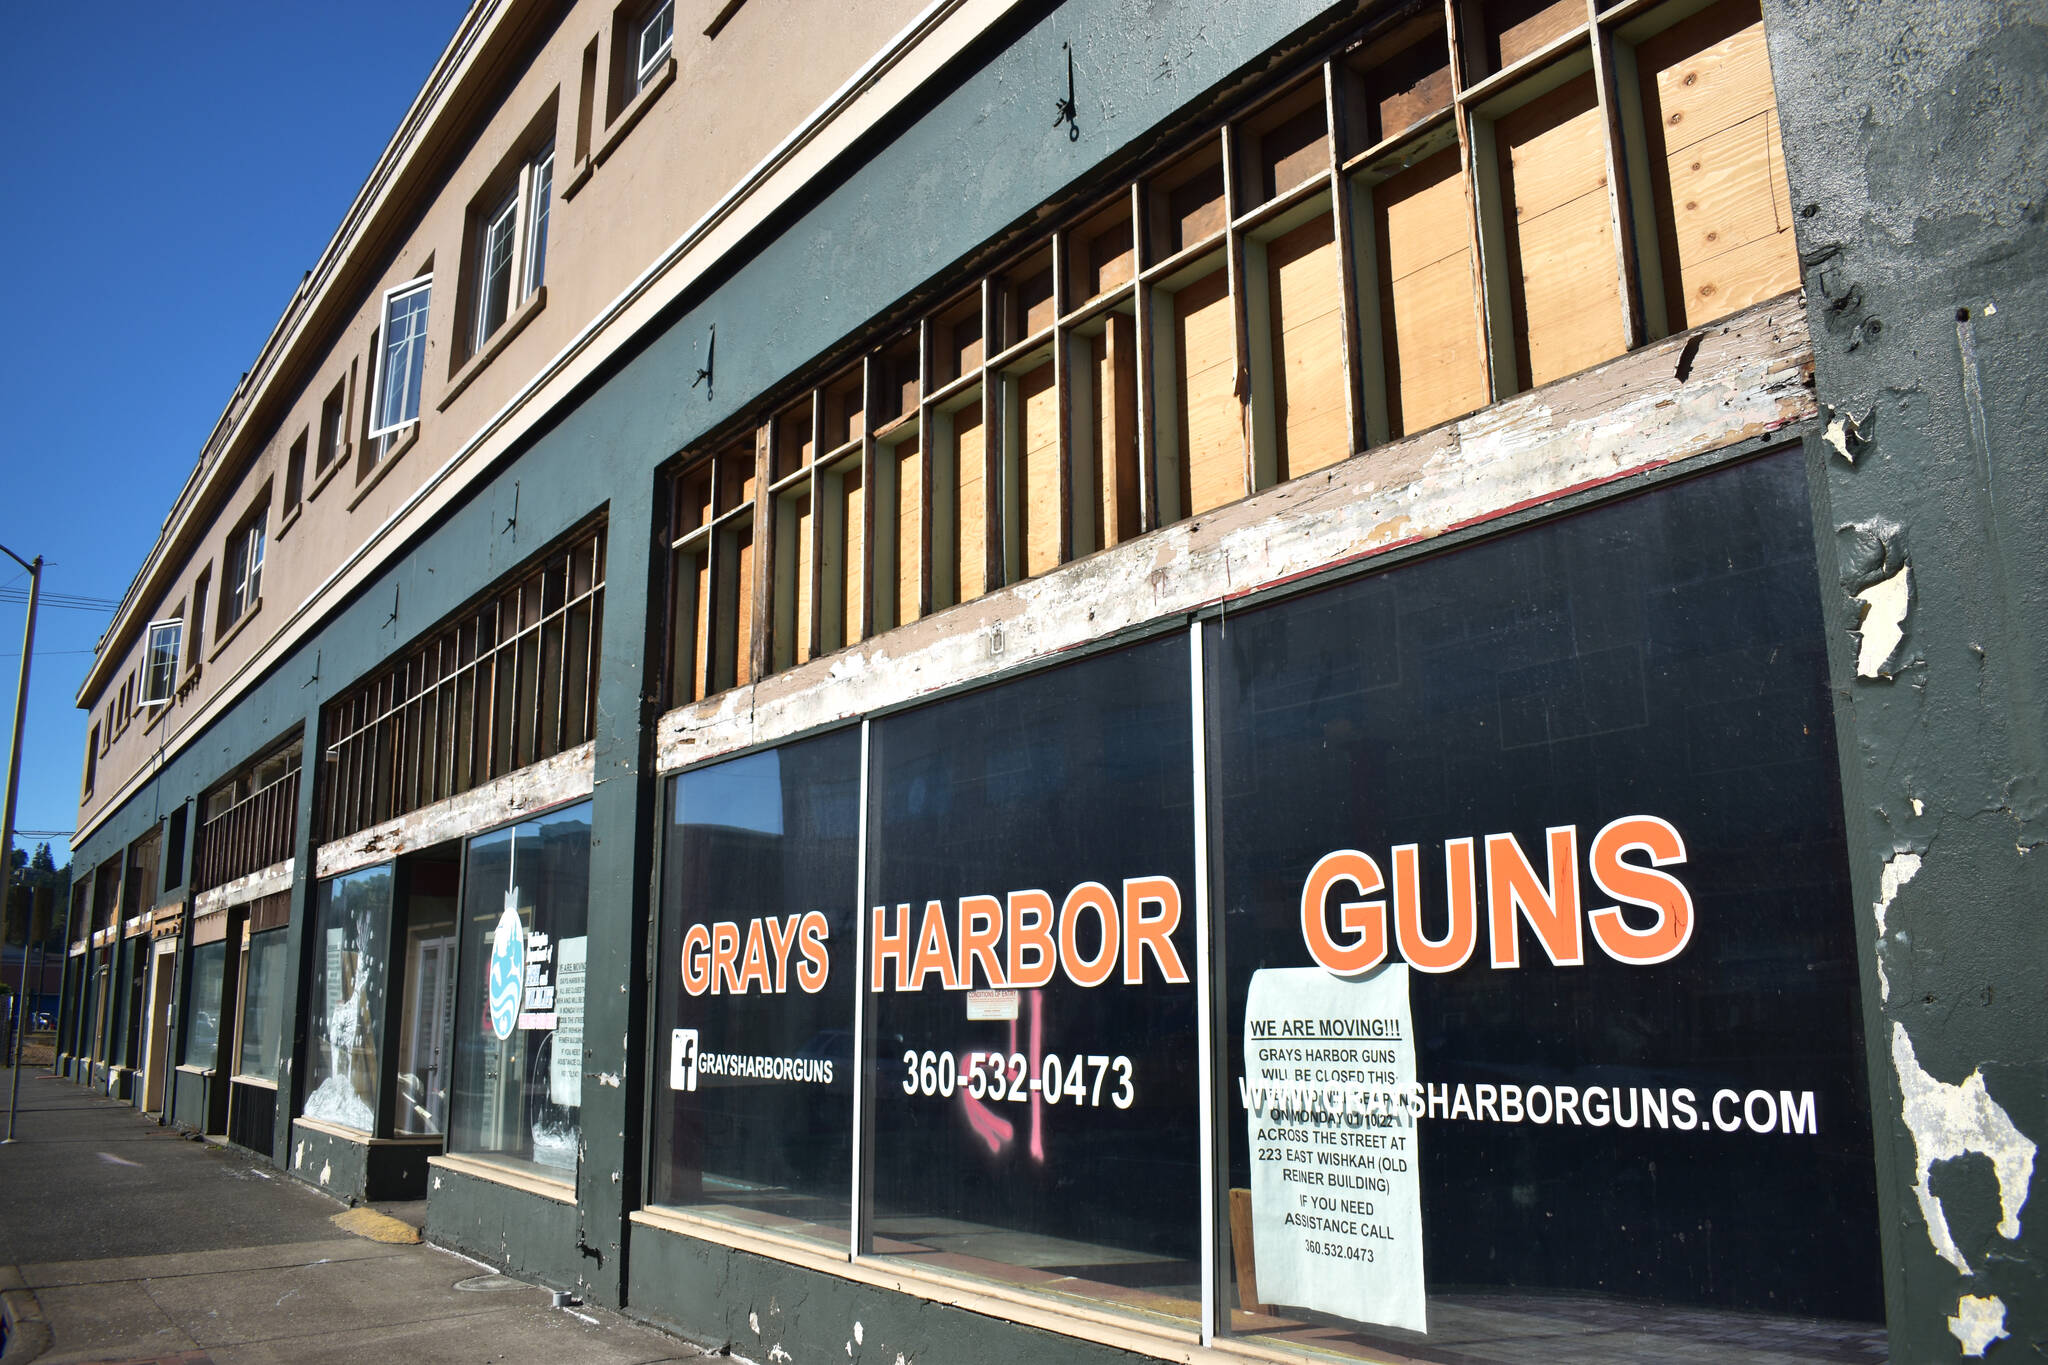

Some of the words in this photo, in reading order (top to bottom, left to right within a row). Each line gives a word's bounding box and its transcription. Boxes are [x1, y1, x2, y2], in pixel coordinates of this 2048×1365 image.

[1301, 815, 1695, 976] GUNS
[681, 910, 829, 996] GRAYS
[871, 875, 1190, 992] HARBOR
[1250, 1020, 1277, 1037] WE
[1282, 1020, 1315, 1037] ARE
[1319, 1019, 1401, 1037] MOVING!!!
[698, 1052, 833, 1084] GRAYSHARBORGUNS
[1258, 1049, 1302, 1062] GRAYS
[1305, 1049, 1358, 1063] HARBOR
[1361, 1050, 1396, 1064] GUNS
[902, 1049, 1135, 1109] 360-532-0473
[1295, 1069, 1311, 1082] BE
[1316, 1069, 1364, 1084] CLOSED
[1271, 1109, 1289, 1121] ON
[1292, 1110, 1343, 1125] MONDAY
[1347, 1113, 1394, 1128] 01/10/22
[1257, 1128, 1309, 1143] ACROSS
[1313, 1131, 1337, 1145] THE
[1340, 1133, 1387, 1149] STREET
[1391, 1137, 1406, 1151] AT
[1258, 1148, 1282, 1161] 223
[1286, 1149, 1313, 1164] EAST
[1317, 1152, 1375, 1169] WISHKAH
[1378, 1157, 1407, 1174] (OLD
[1283, 1168, 1325, 1186] REINER
[1328, 1173, 1390, 1195] BUILDING)
[1299, 1194, 1308, 1207] IF
[1311, 1196, 1337, 1212] YOU
[1341, 1199, 1374, 1216] NEED
[1284, 1212, 1357, 1235] ASSISTANCE
[1361, 1223, 1395, 1240] CALL
[1305, 1239, 1375, 1263] 360.532.0473
